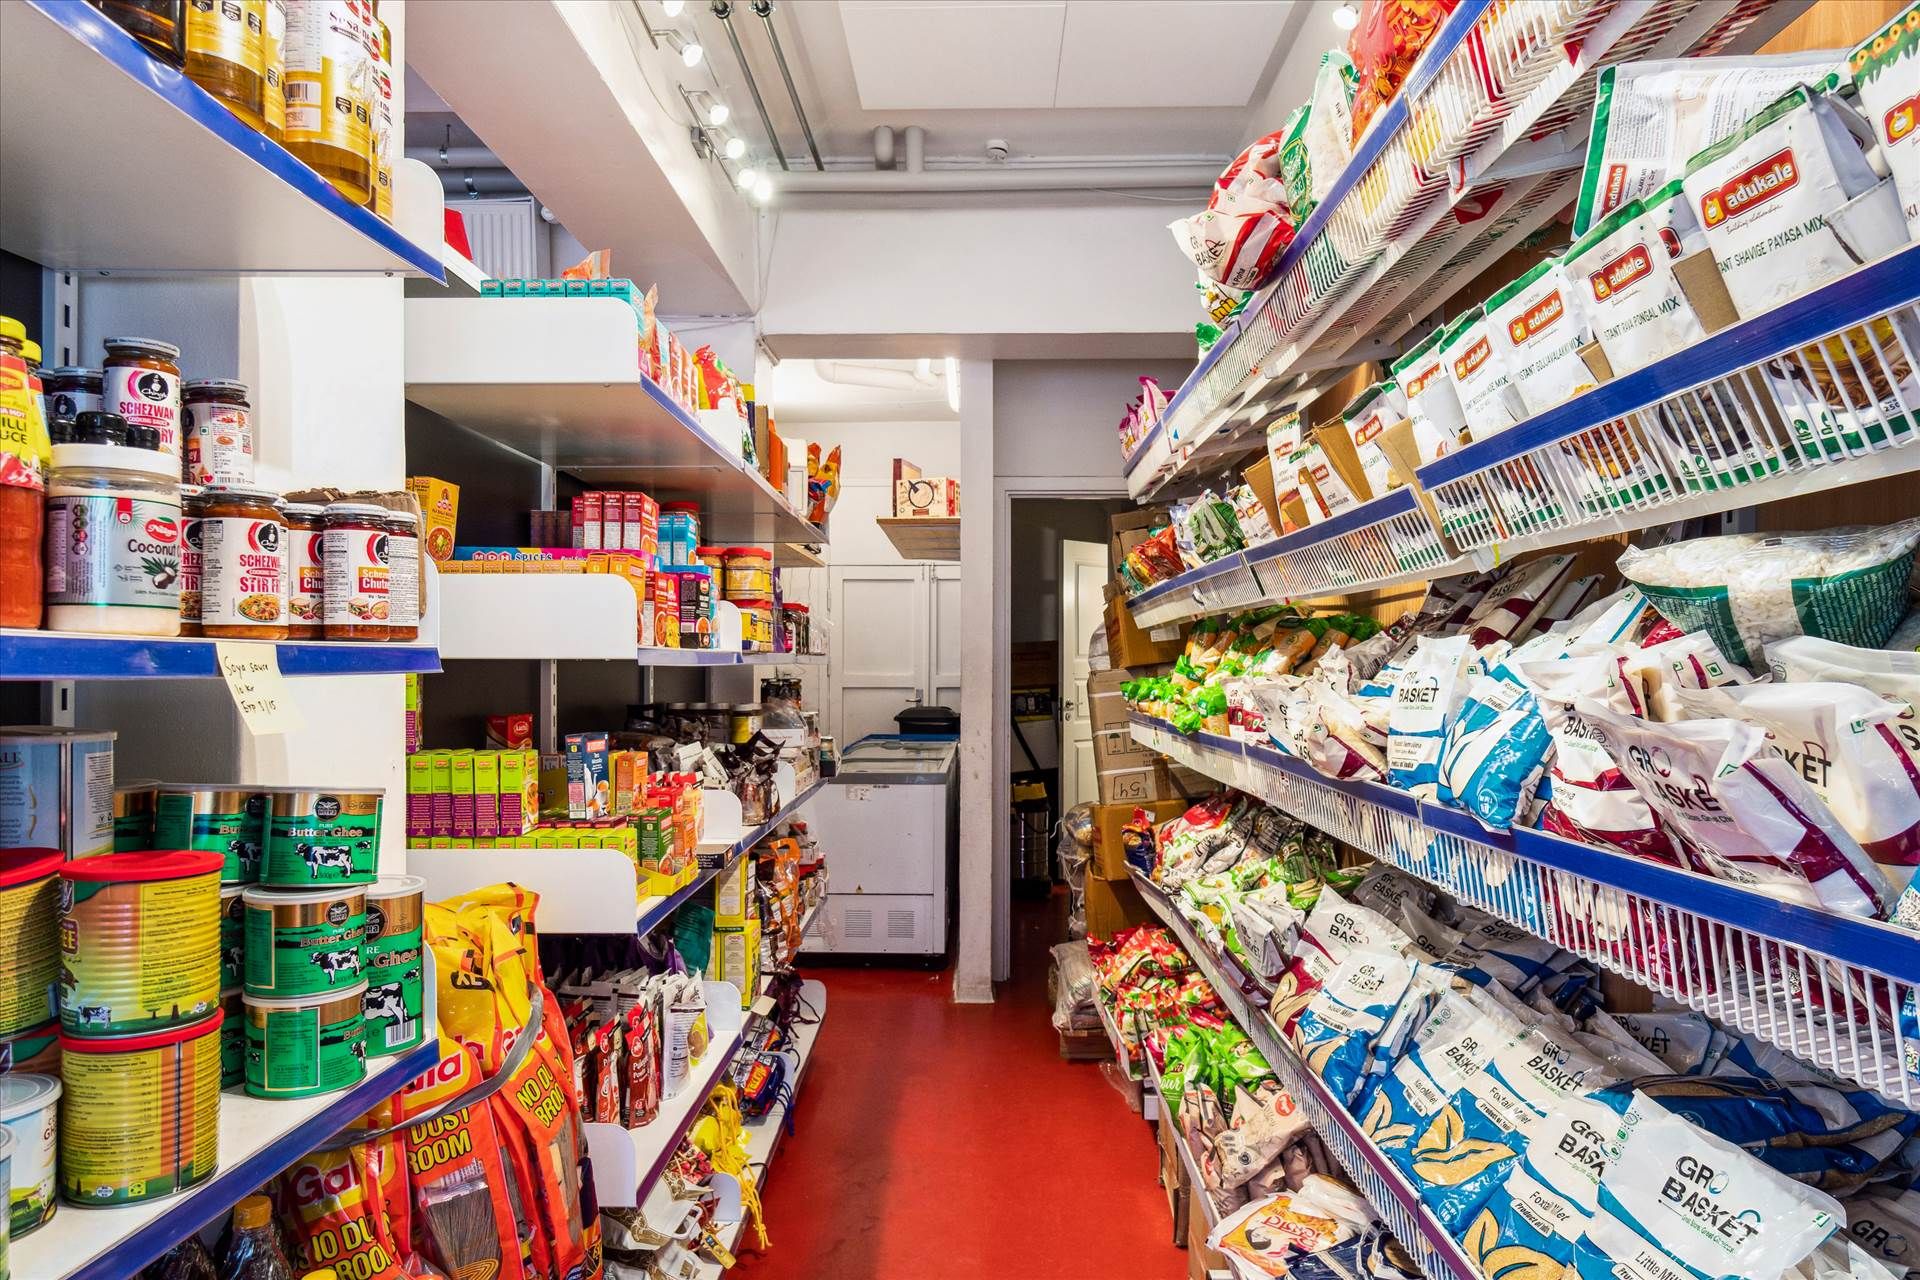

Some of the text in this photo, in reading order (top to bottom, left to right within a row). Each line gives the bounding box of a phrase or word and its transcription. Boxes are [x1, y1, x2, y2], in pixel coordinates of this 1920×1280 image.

[1726, 162, 1794, 209] adukale
[1734, 241, 1767, 268] SHAVIGE
[1768, 226, 1804, 252] PAYASA
[1804, 213, 1828, 234] MIX
[1608, 256, 1646, 286] adukale
[1527, 298, 1562, 331] adukale
[1659, 295, 1681, 315] MIX
[119, 401, 175, 420] SCHEZWAN
[127, 538, 176, 557] Coconut
[240, 577, 267, 593] STIR
[224, 656, 246, 679] Soya
[1399, 687, 1439, 703] BASKET
[1628, 744, 1672, 778] GRO
[287, 827, 364, 838] Butter Ghee
[300, 934, 342, 948] Butter
[374, 948, 418, 968] Ghee
[1444, 1045, 1481, 1078] BASKET
[1542, 1040, 1571, 1066] GRO
[1526, 1055, 1584, 1092] BASKET
[516, 1080, 541, 1112] NO
[1489, 1086, 1515, 1111] Foxtail
[410, 1106, 471, 1146] DUST
[1675, 1155, 1730, 1195] GRO
[1660, 1175, 1760, 1245] BASKET
[1851, 1219, 1908, 1257] GRO
[1634, 1250, 1661, 1276] Little
